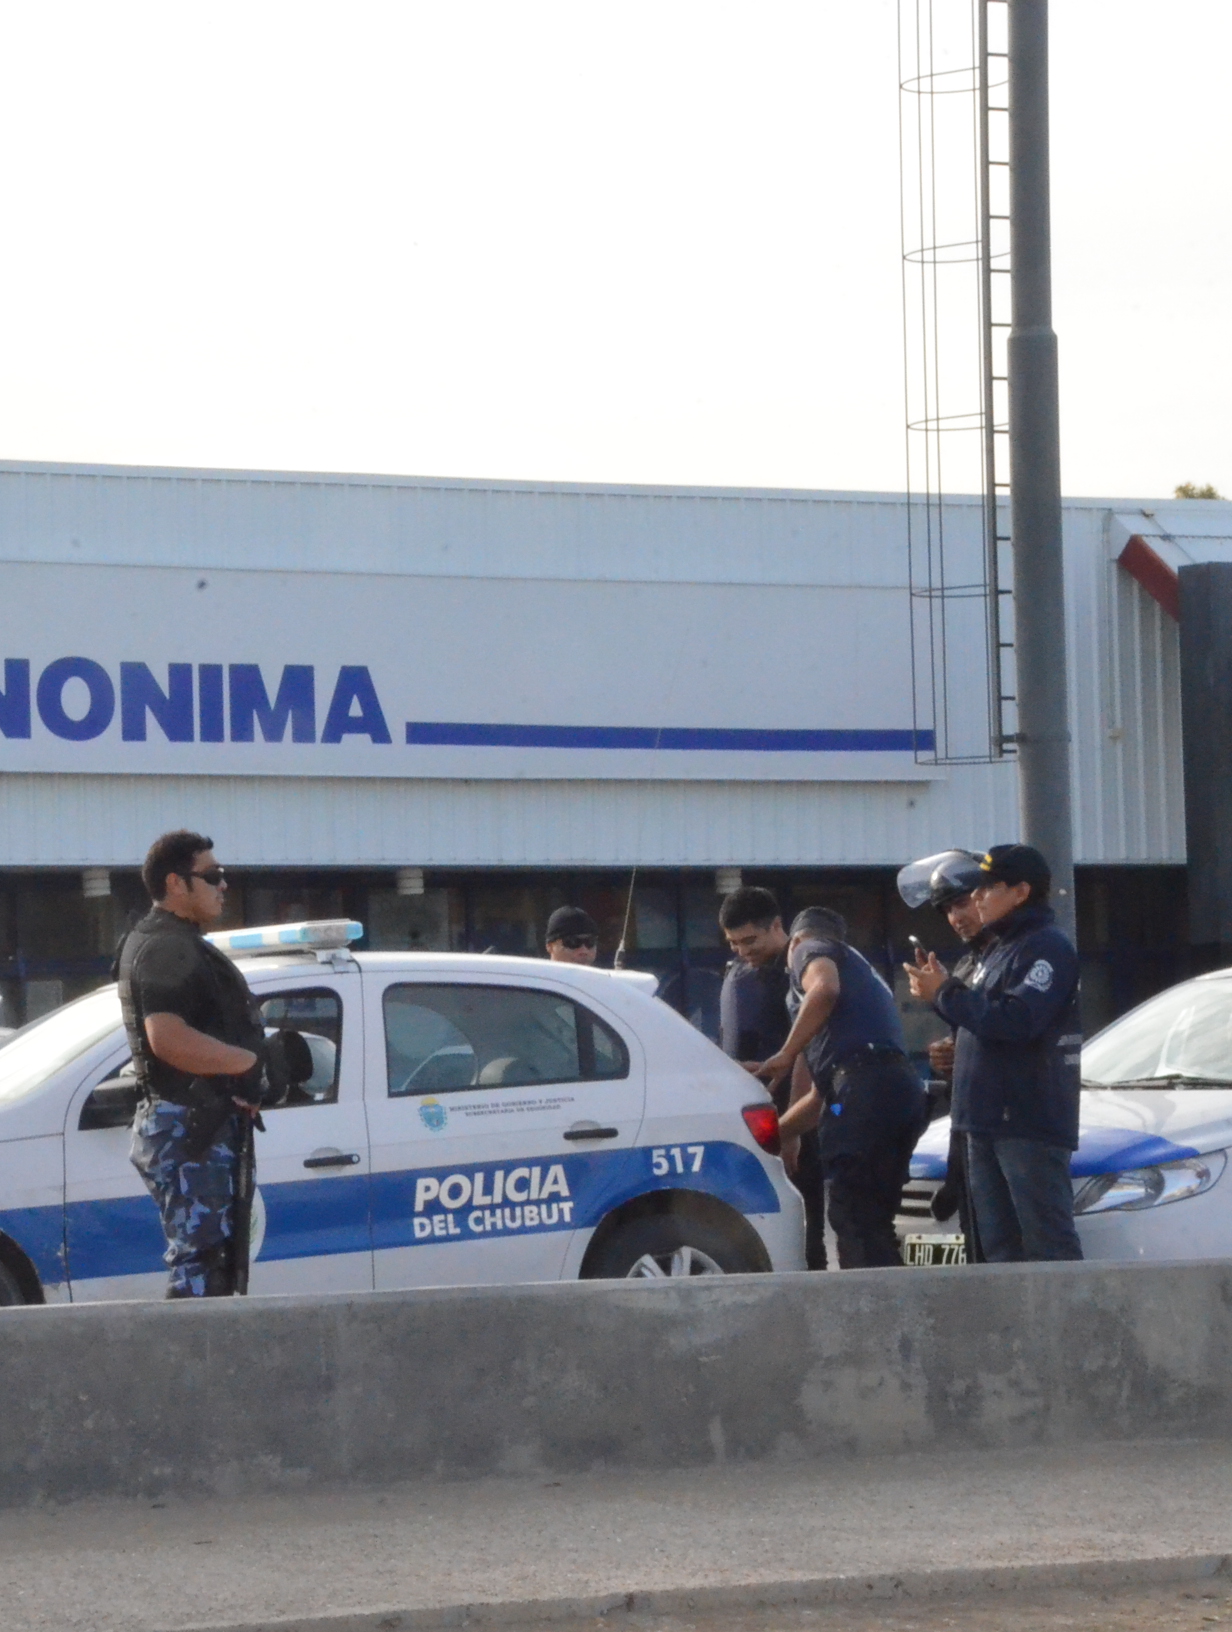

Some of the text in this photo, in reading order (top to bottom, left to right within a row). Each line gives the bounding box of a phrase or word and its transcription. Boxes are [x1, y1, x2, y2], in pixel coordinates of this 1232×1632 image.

[651, 1145, 705, 1176] 517
[414, 1164, 571, 1213] POLICIA
[413, 1201, 574, 1239] DEL CHUBUT
[906, 1244, 967, 1266] LHD 776
